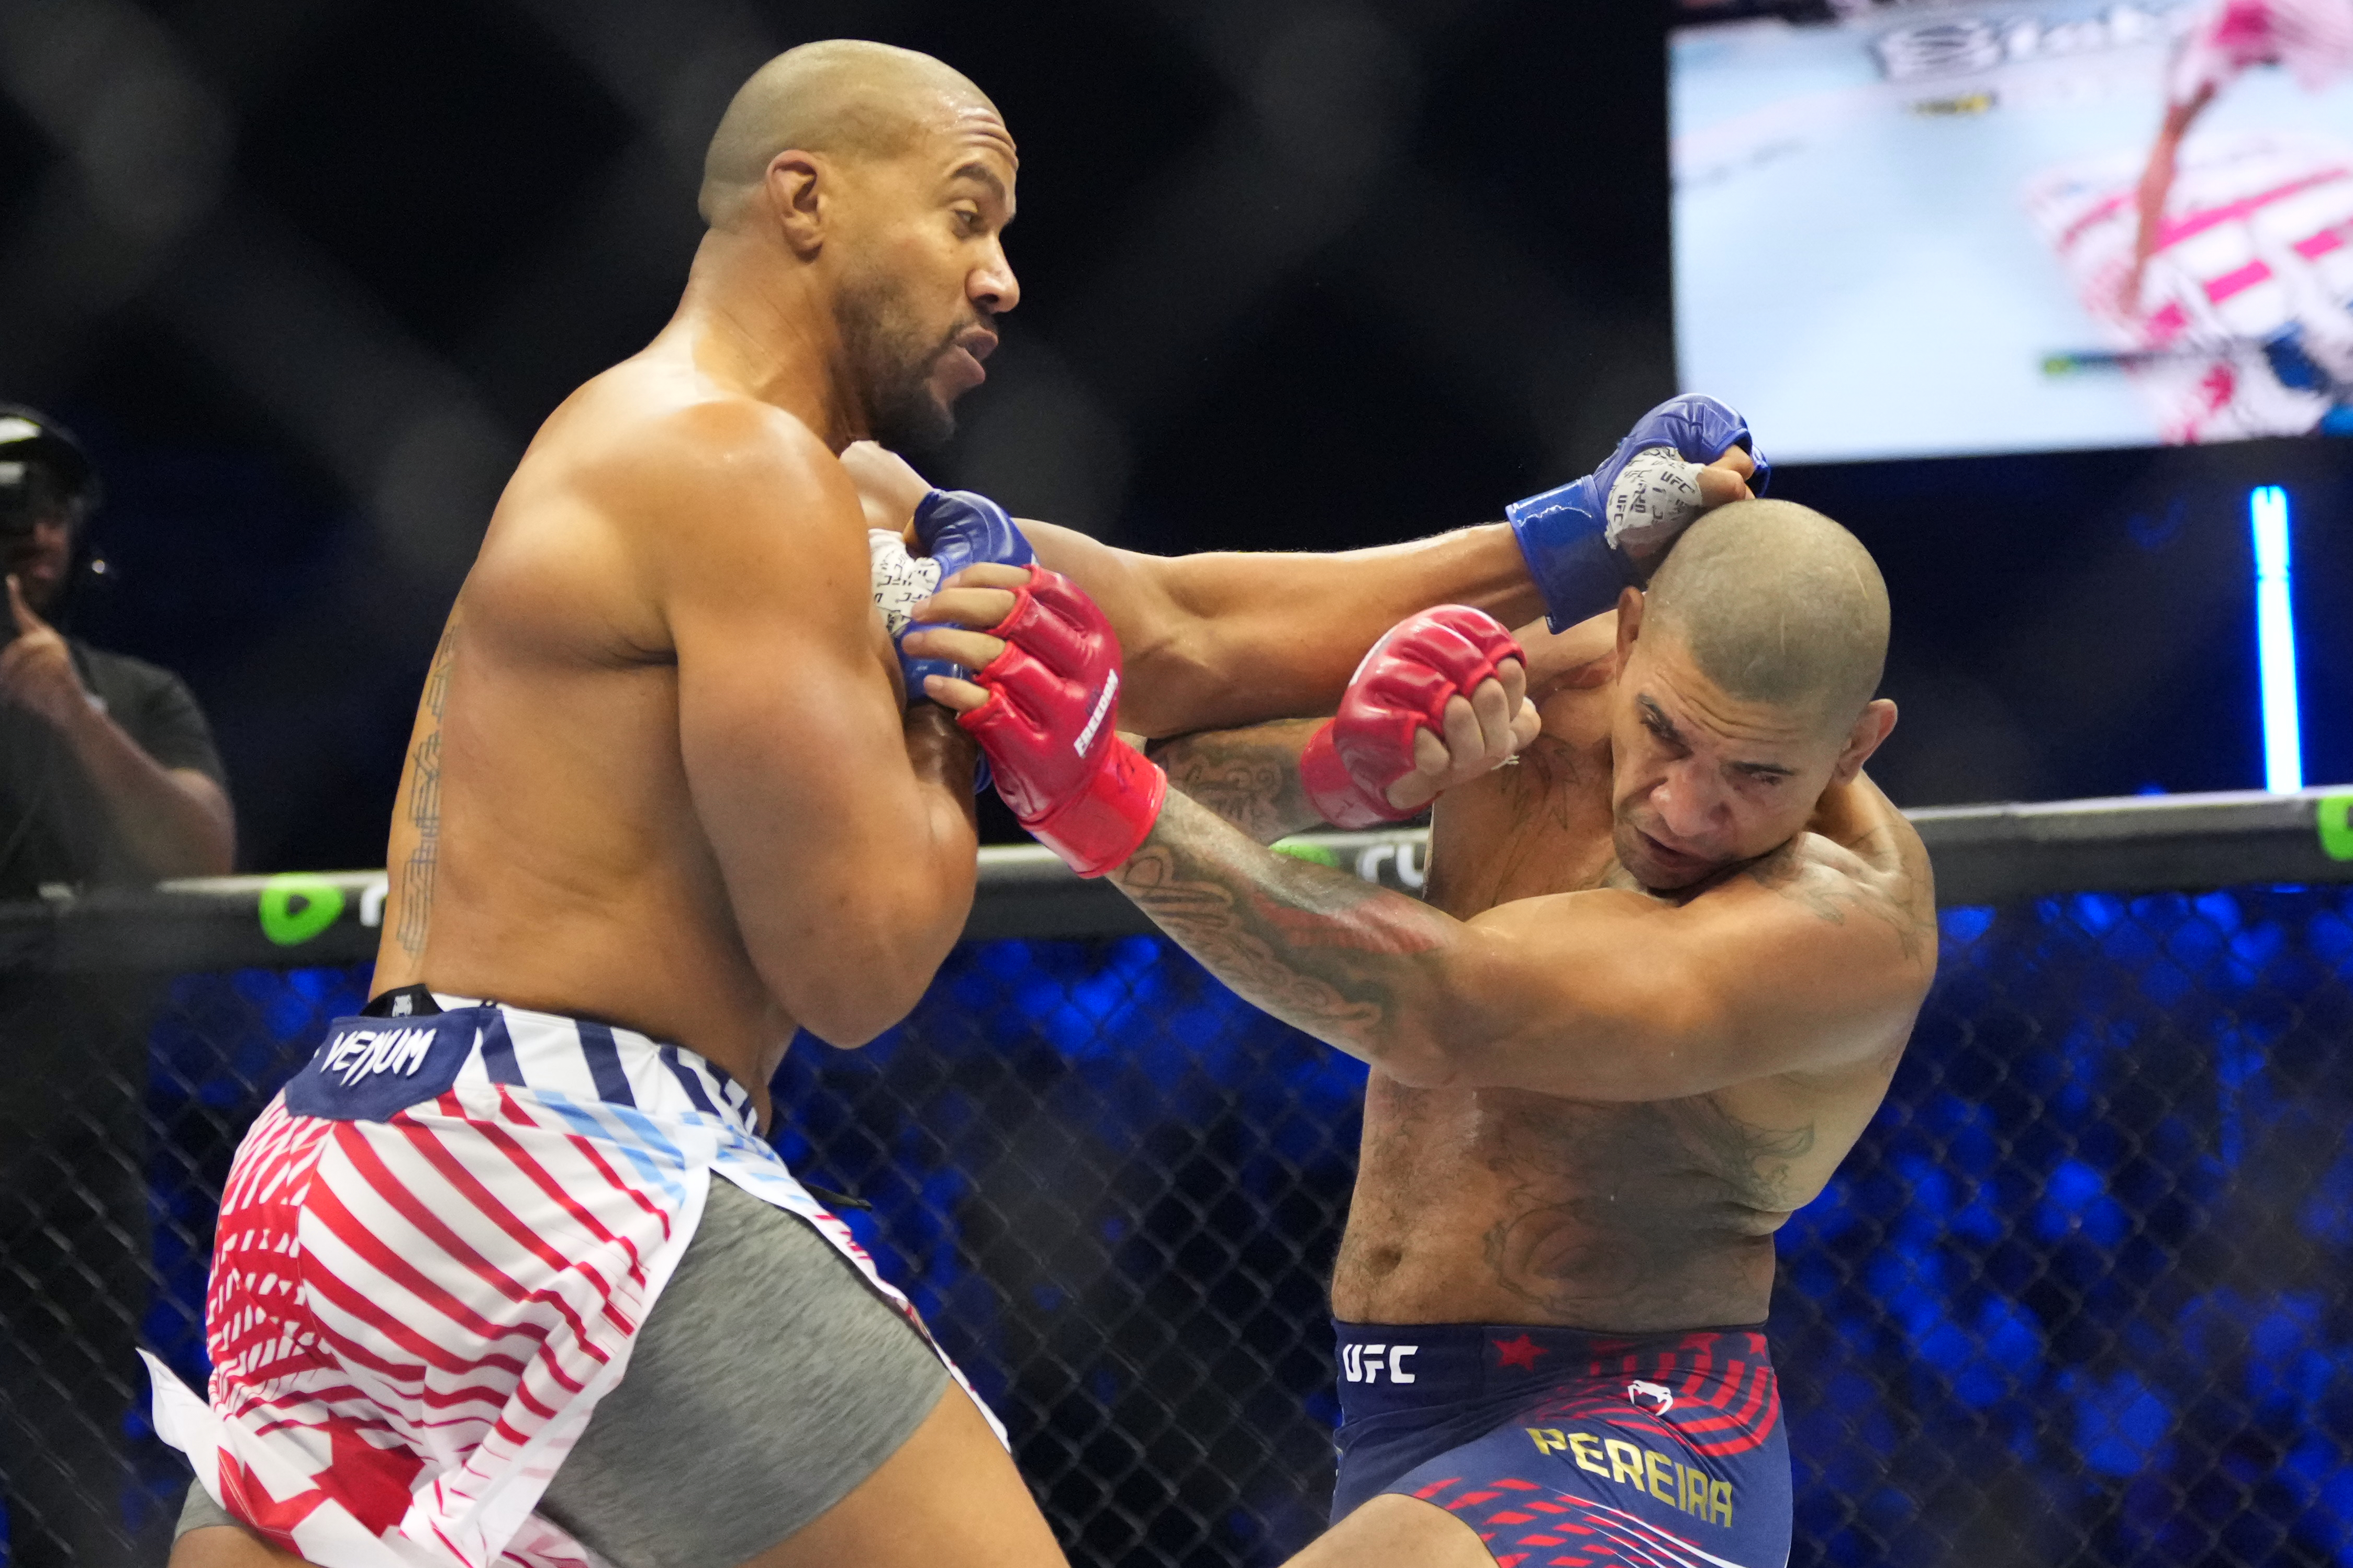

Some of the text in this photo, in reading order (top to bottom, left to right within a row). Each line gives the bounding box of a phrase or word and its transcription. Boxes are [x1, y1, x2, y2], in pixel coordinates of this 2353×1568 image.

[1660, 471, 1696, 495] UFC
[1614, 495, 1629, 525] UFC
[895, 592, 928, 603] FC
[320, 1027, 437, 1086] VENUM
[1342, 1344, 1419, 1383] UFC
[1524, 1427, 1733, 1528] PEREIRA
